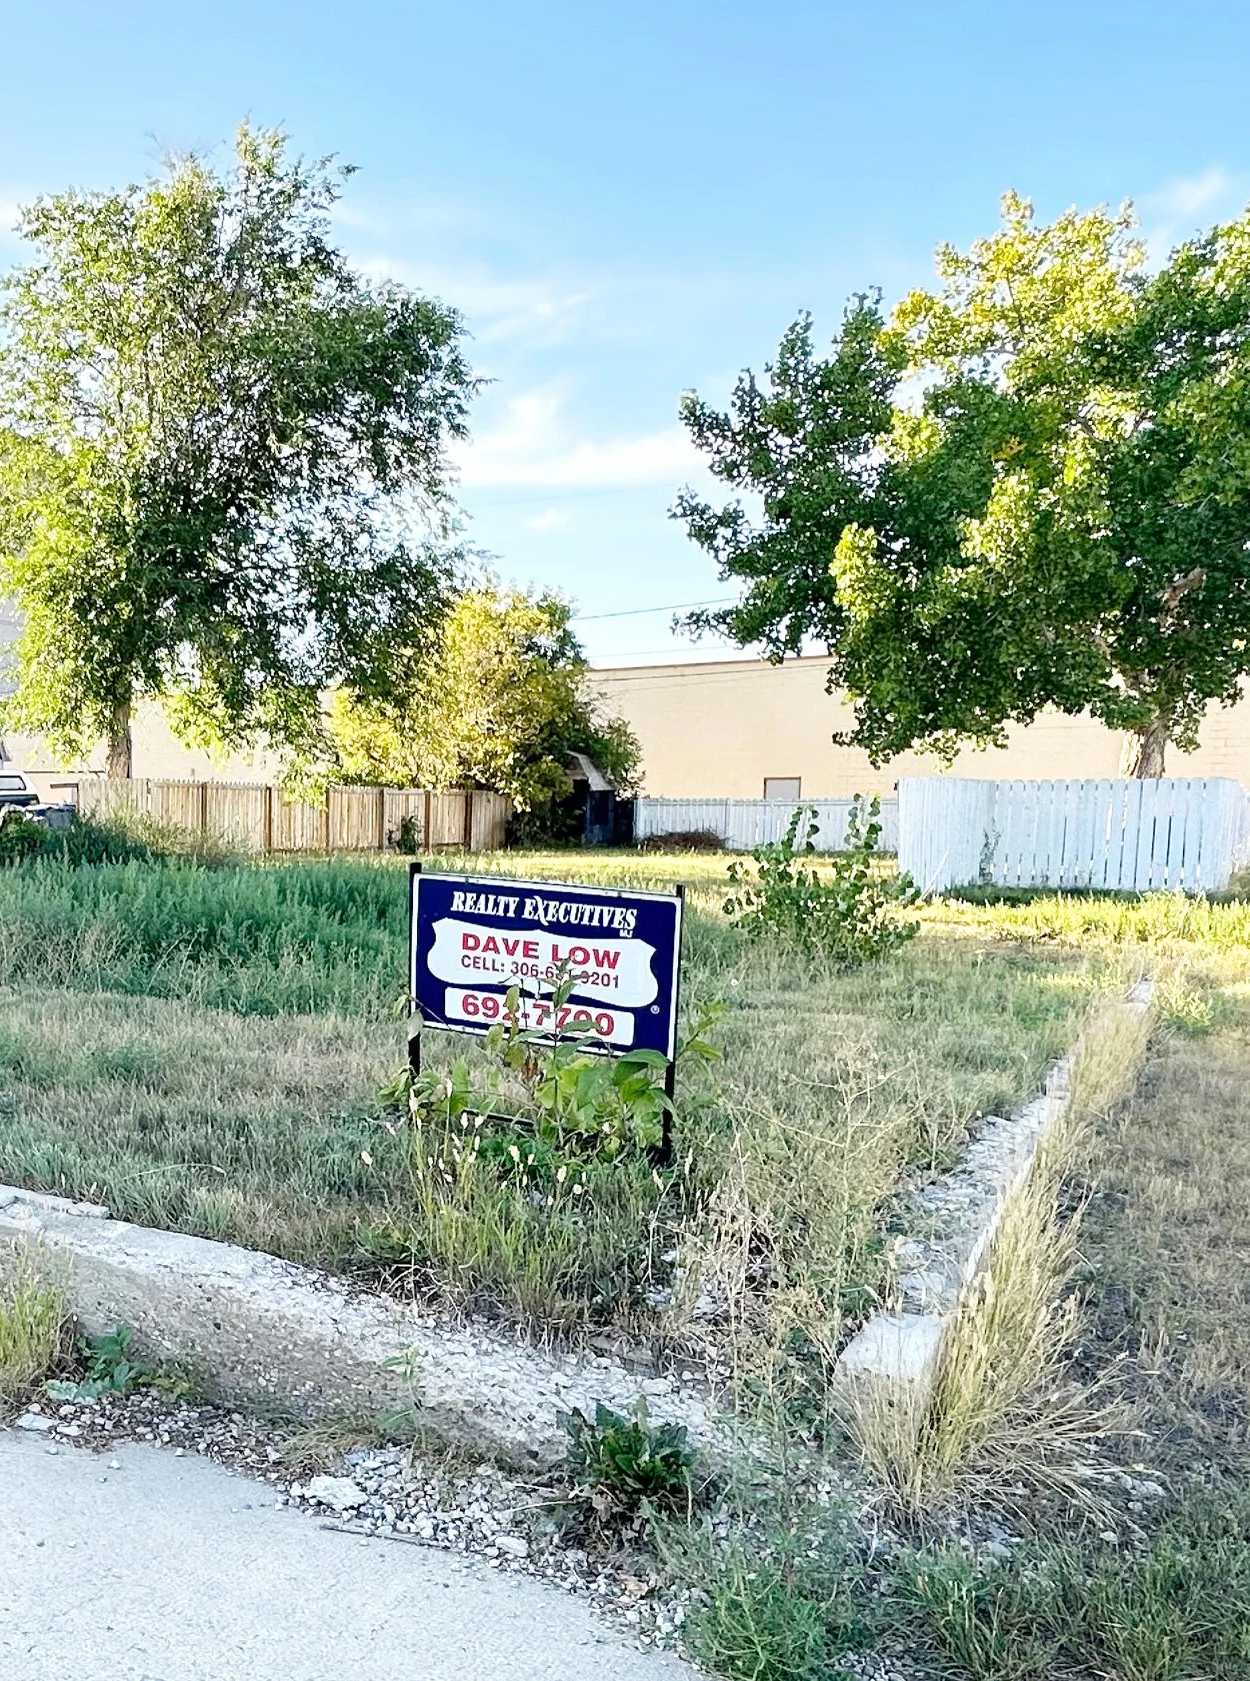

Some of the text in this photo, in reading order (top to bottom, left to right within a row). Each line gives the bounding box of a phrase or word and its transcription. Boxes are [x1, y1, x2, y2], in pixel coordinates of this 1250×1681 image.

[451, 891, 637, 930] REALTY EXECUTIVES
[461, 955, 505, 972] CELL:
[462, 933, 621, 970] DAVE LOW
